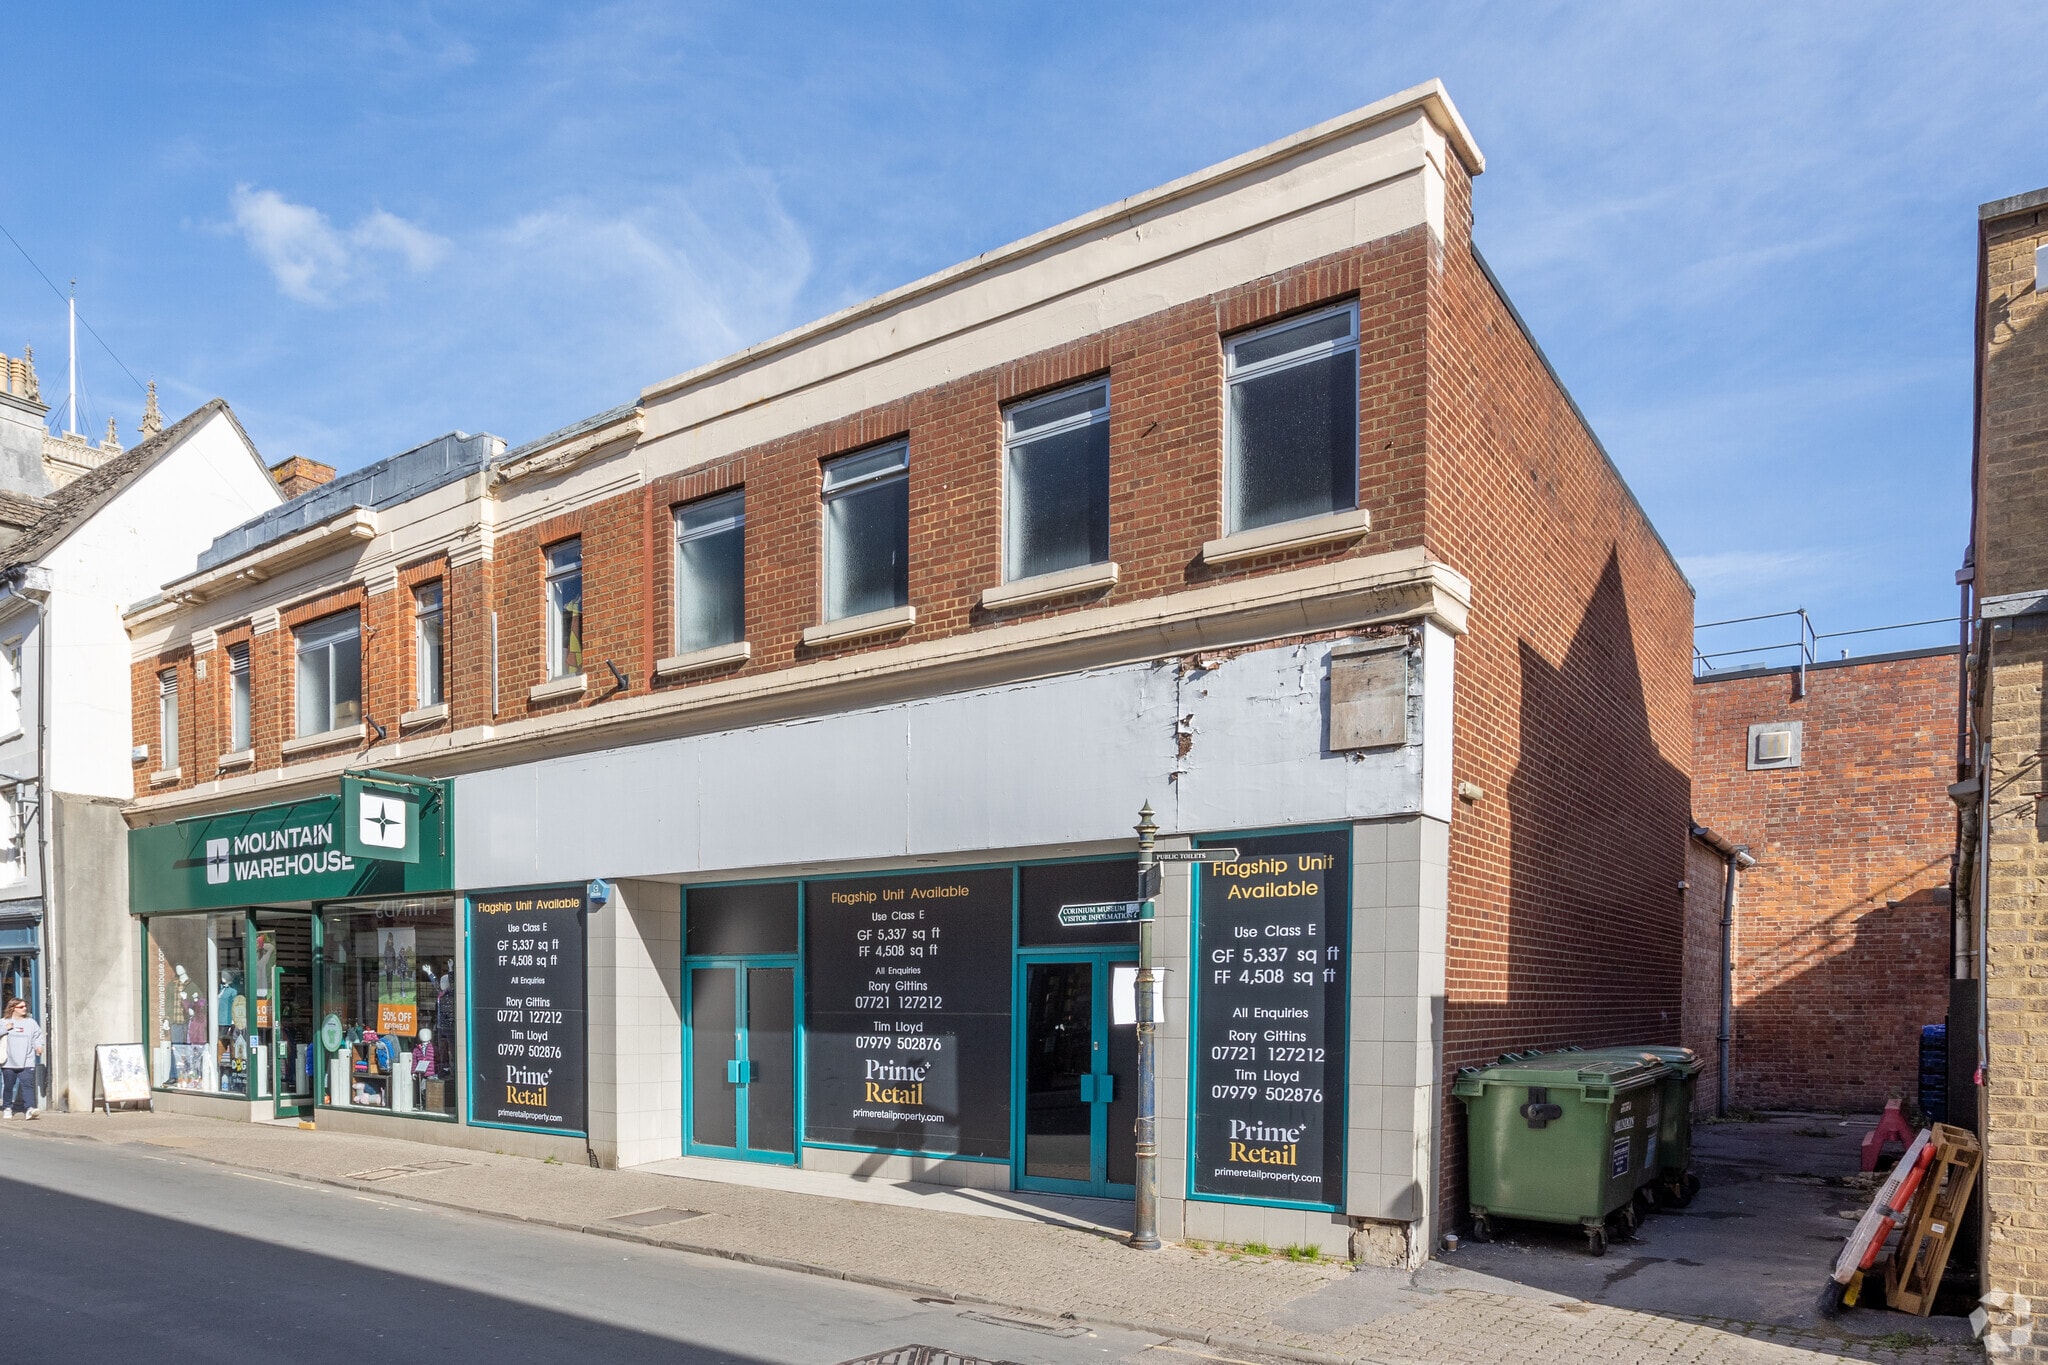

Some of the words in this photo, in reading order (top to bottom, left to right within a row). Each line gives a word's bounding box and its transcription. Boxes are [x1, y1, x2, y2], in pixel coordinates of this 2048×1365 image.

[234, 823, 332, 855] MOUNTAIN
[234, 850, 355, 881] WAREHOUSE
[1212, 857, 1288, 878] Flagship
[1299, 855, 1334, 871] Unit
[832, 891, 876, 905] Flagship
[883, 889, 904, 900] Unit
[911, 885, 969, 899] Available
[1228, 881, 1318, 899] Available
[479, 902, 512, 914] Flagship
[516, 901, 532, 910] Unit
[537, 898, 579, 909] Available
[1063, 906, 1096, 915] CORINIUM
[1097, 905, 1125, 913] MUSEUM
[872, 913, 887, 921] Use
[892, 911, 915, 920] Class
[919, 910, 924, 919] E
[1088, 913, 1132, 921] INFORMATION
[508, 924, 519, 932] Use
[522, 924, 540, 932] Class
[543, 923, 547, 931] E
[857, 930, 872, 940] GF
[878, 929, 906, 940] 5,337
[913, 930, 925, 941] sq
[932, 927, 940, 938] ft
[1235, 927, 1257, 938] Use
[1265, 925, 1301, 936] Class
[1309, 924, 1316, 935] E
[497, 940, 508, 950] GF
[513, 940, 534, 951] 5,337
[538, 942, 548, 952] sq
[552, 939, 559, 949] ft
[859, 946, 870, 956] FF
[876, 945, 904, 957] 4,508
[911, 947, 923, 958] sq
[929, 944, 938, 955] ft
[499, 956, 507, 965] FF
[511, 955, 532, 966] 4,508
[537, 957, 546, 967] sq
[551, 955, 557, 965] ft
[1212, 949, 1234, 963] GF
[1243, 948, 1287, 963] 5,337
[1298, 950, 1316, 964] sq
[1327, 946, 1339, 960] ft
[888, 967, 920, 975] Enquiries
[1215, 970, 1231, 984] FF
[1239, 969, 1284, 984] 4,508
[1294, 972, 1313, 985] sq
[1323, 969, 1336, 982] ft
[521, 977, 545, 985] Enquiries
[869, 981, 890, 993] Rory
[895, 981, 927, 990] Gittins
[506, 997, 522, 1008] Rory
[526, 997, 550, 1007] Gittins
[856, 996, 889, 1008] 07721
[899, 996, 942, 1008] 127212
[382, 1011, 397, 1022] 50%
[398, 1011, 412, 1023] OFF
[498, 1010, 522, 1022] 07721
[530, 1011, 561, 1023] 127212
[1233, 1008, 1247, 1017] All
[1255, 1008, 1308, 1020] Enquiries
[874, 1021, 890, 1031] Tim
[896, 1022, 922, 1034] Lloyd
[511, 1030, 523, 1039] Tim
[527, 1031, 547, 1042] Lloyd
[856, 1036, 891, 1049] 07979
[897, 1037, 941, 1050] 502876
[1229, 1030, 1257, 1043] Rory
[1264, 1031, 1306, 1041] Gittins
[498, 1044, 524, 1056] 07979
[529, 1046, 561, 1058] 502876
[1212, 1047, 1255, 1060] 07721
[1269, 1048, 1324, 1062] 127212
[507, 1065, 549, 1085] Prime
[866, 1060, 925, 1081] Prime
[1235, 1069, 1256, 1080] Tim
[1264, 1070, 1299, 1084] Lloyd
[507, 1086, 547, 1106] Retail
[866, 1082, 922, 1104] Retail
[1212, 1085, 1257, 1099] 07979
[1266, 1087, 1322, 1102] 502876
[498, 1110, 562, 1122] primeretailproperty.com
[853, 1108, 944, 1122] primeretailproperty.com
[1230, 1120, 1299, 1142] Prime
[1230, 1142, 1296, 1165] Retail
[1215, 1169, 1321, 1182] primeretailproperty.com
